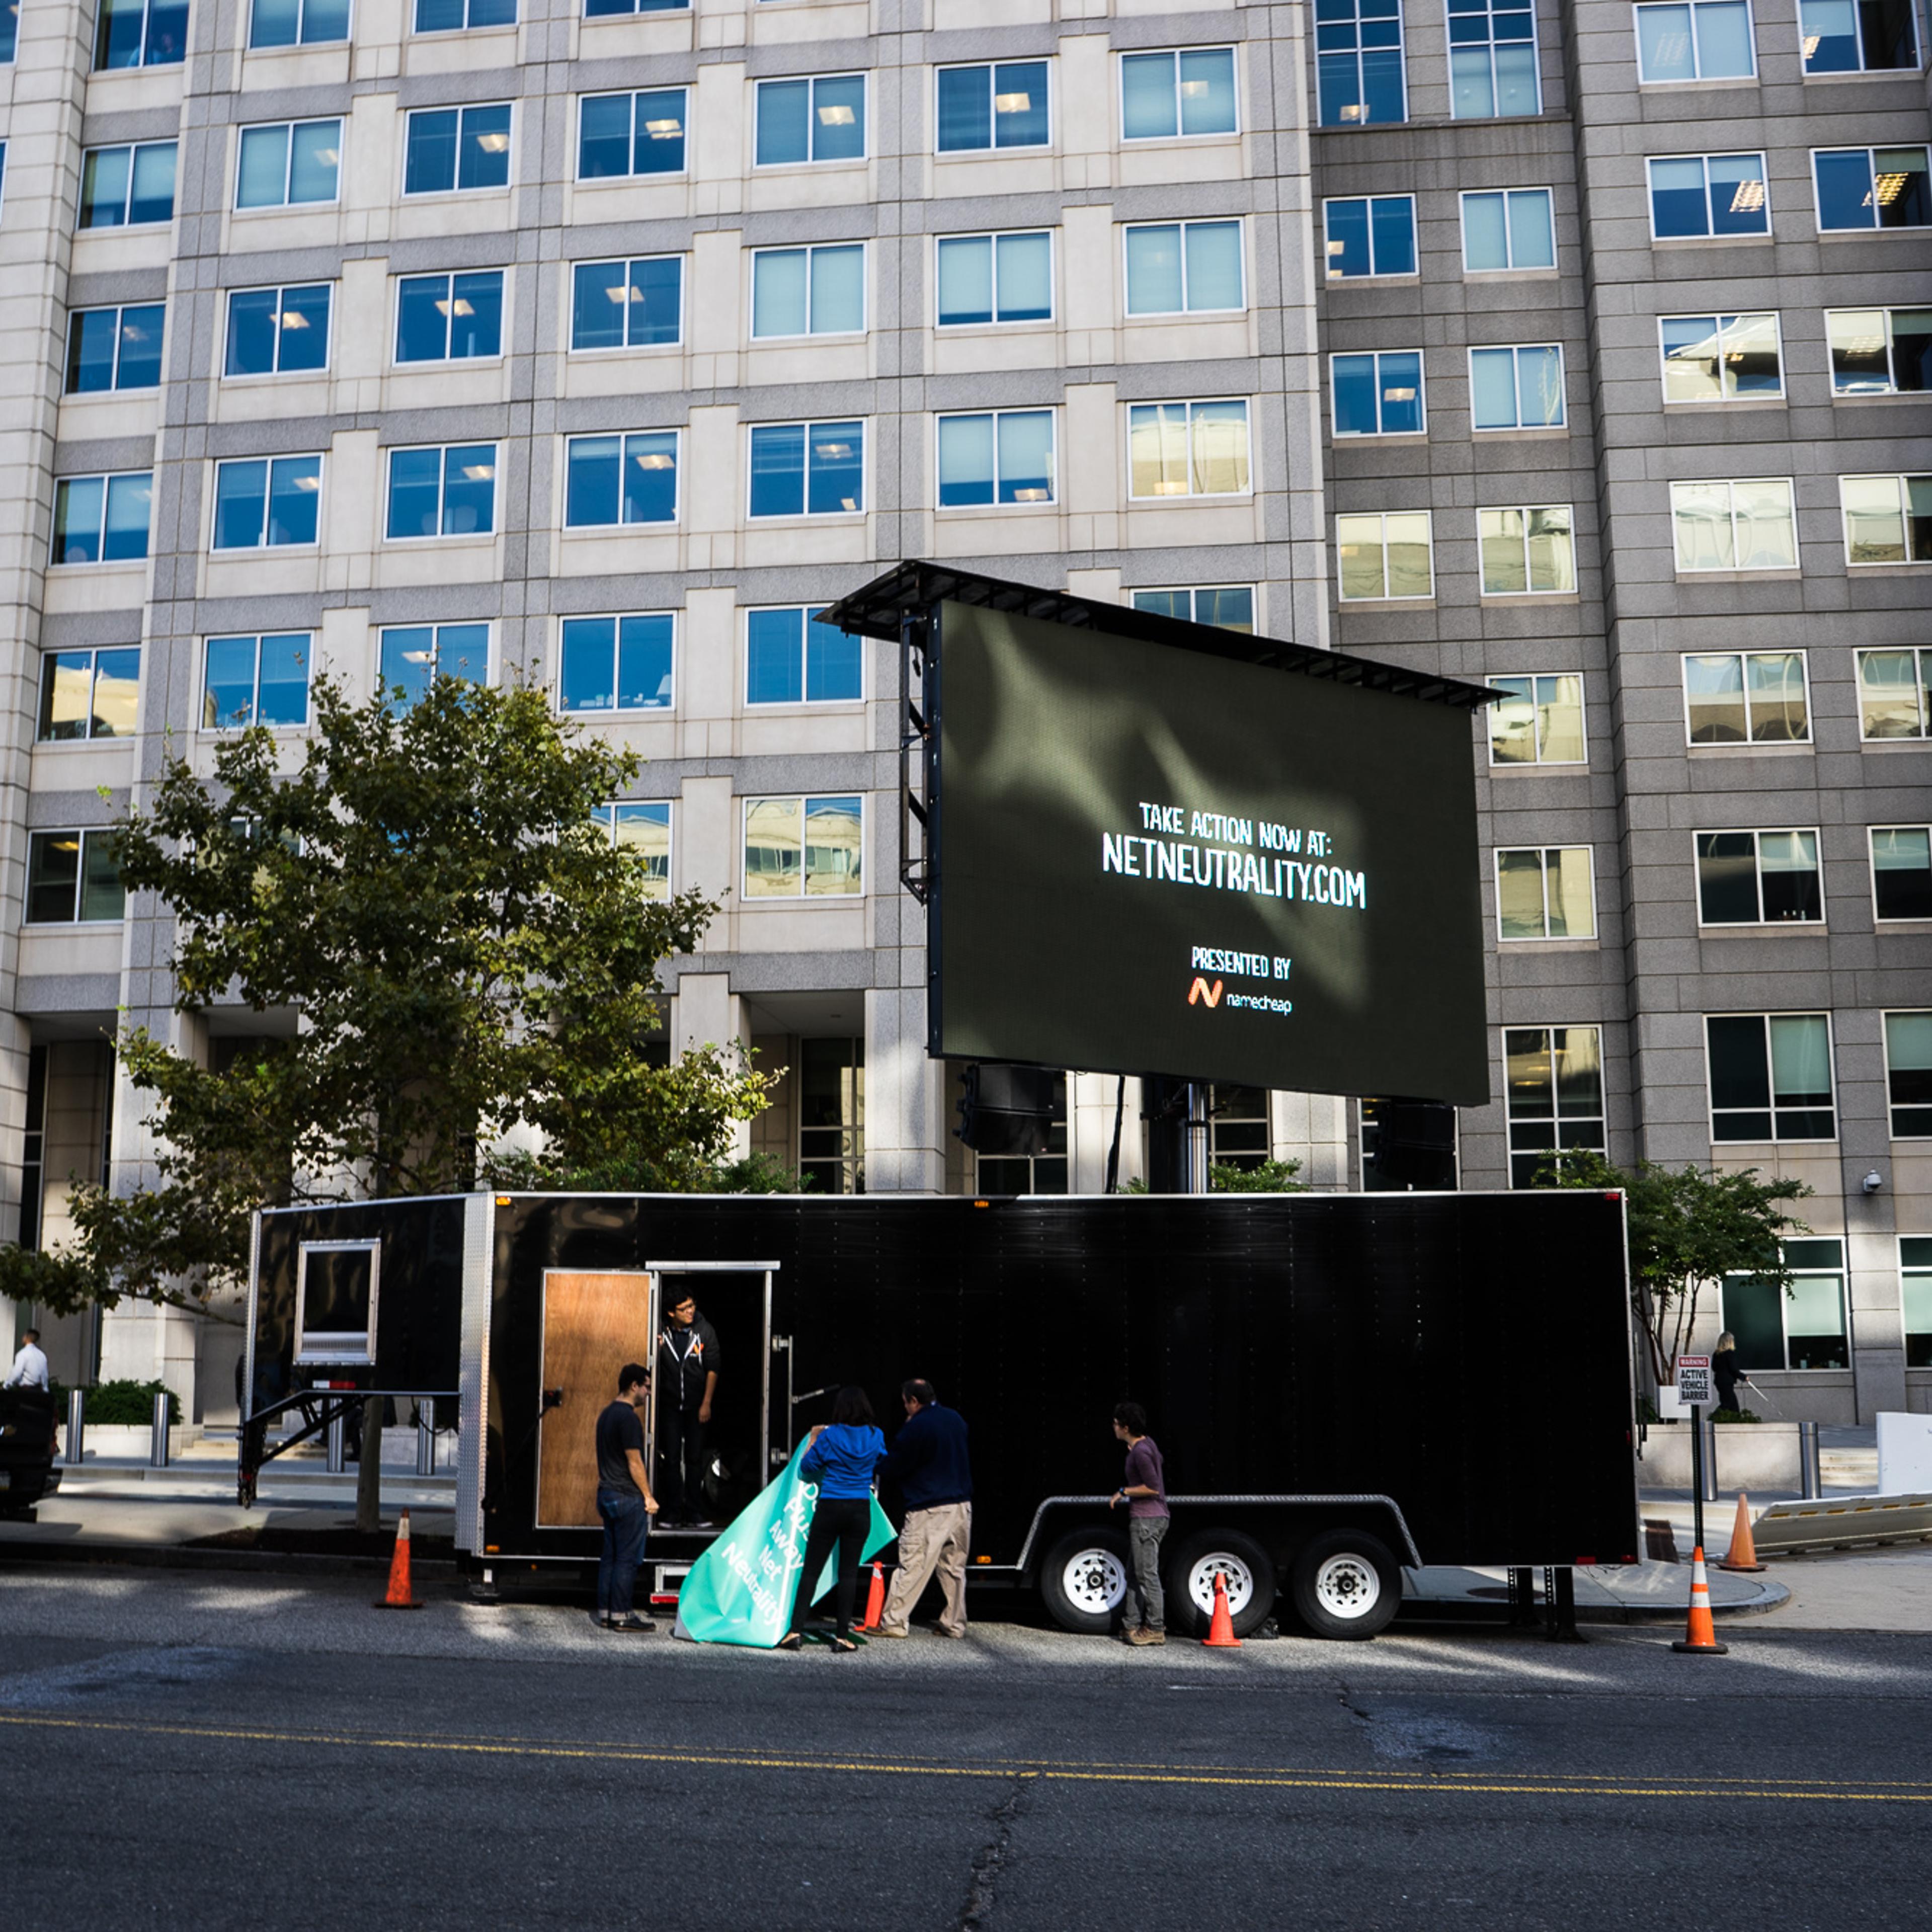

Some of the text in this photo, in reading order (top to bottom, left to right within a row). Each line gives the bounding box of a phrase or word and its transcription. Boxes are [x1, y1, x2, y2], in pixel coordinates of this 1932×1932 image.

[1139, 802, 1332, 857] TAKE ACTION NOW AT:
[1102, 832, 1366, 910] NETNEUTRALITY.COM
[1191, 946, 1291, 980] PRESENTED BY
[1226, 994, 1292, 1016] namecheap
[1680, 1369, 1708, 1379] ACTIVE
[1680, 1380, 1709, 1390] VEHICLE
[1681, 1391, 1709, 1401] BARRIER
[769, 1519, 804, 1569] Away
[758, 1544, 782, 1582] Net
[721, 1541, 785, 1626] Neutrality
